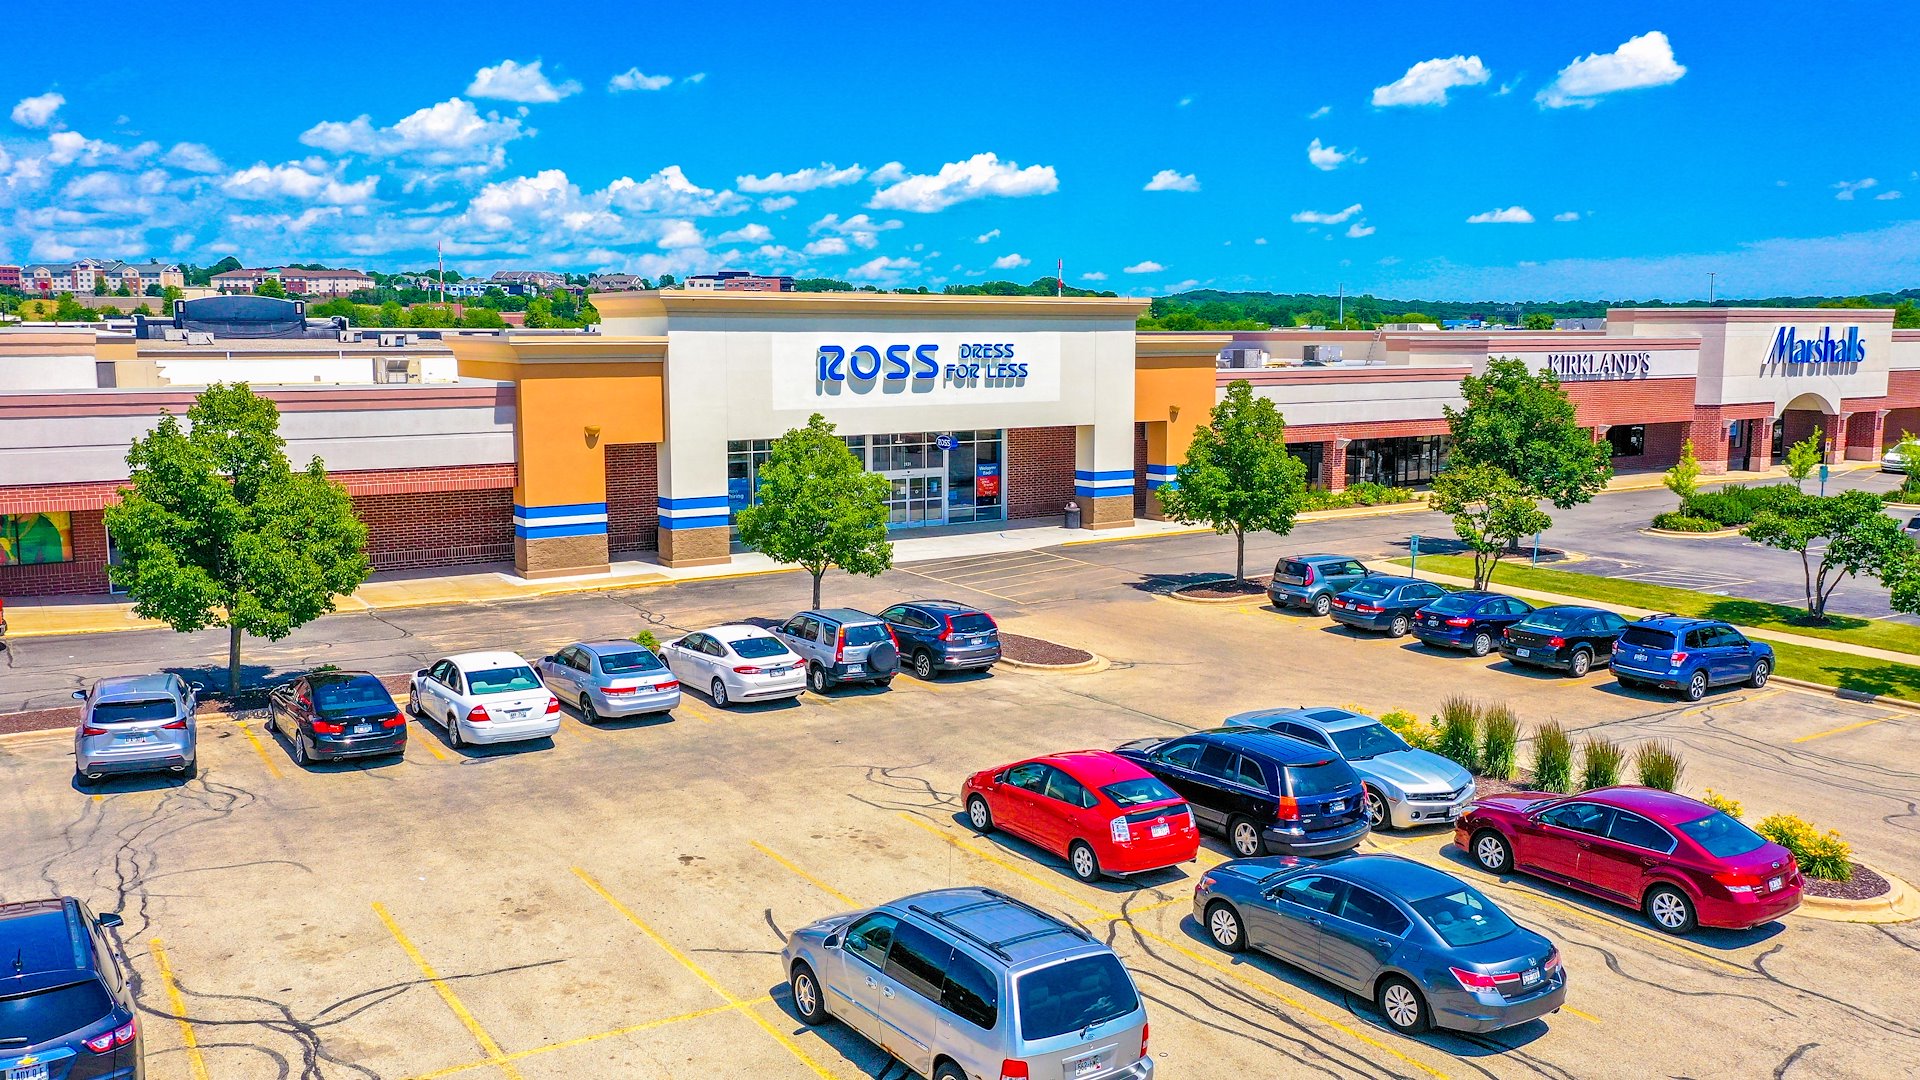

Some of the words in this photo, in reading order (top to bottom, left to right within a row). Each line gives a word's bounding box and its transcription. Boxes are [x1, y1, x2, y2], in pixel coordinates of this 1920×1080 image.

[959, 343, 1014, 359] DRESS
[1766, 326, 1866, 364] Marshalls
[819, 344, 940, 381] ROSS
[945, 363, 980, 379] FOR
[986, 363, 1029, 378] LESS
[1549, 352, 1651, 375] KIRKLAND'S
